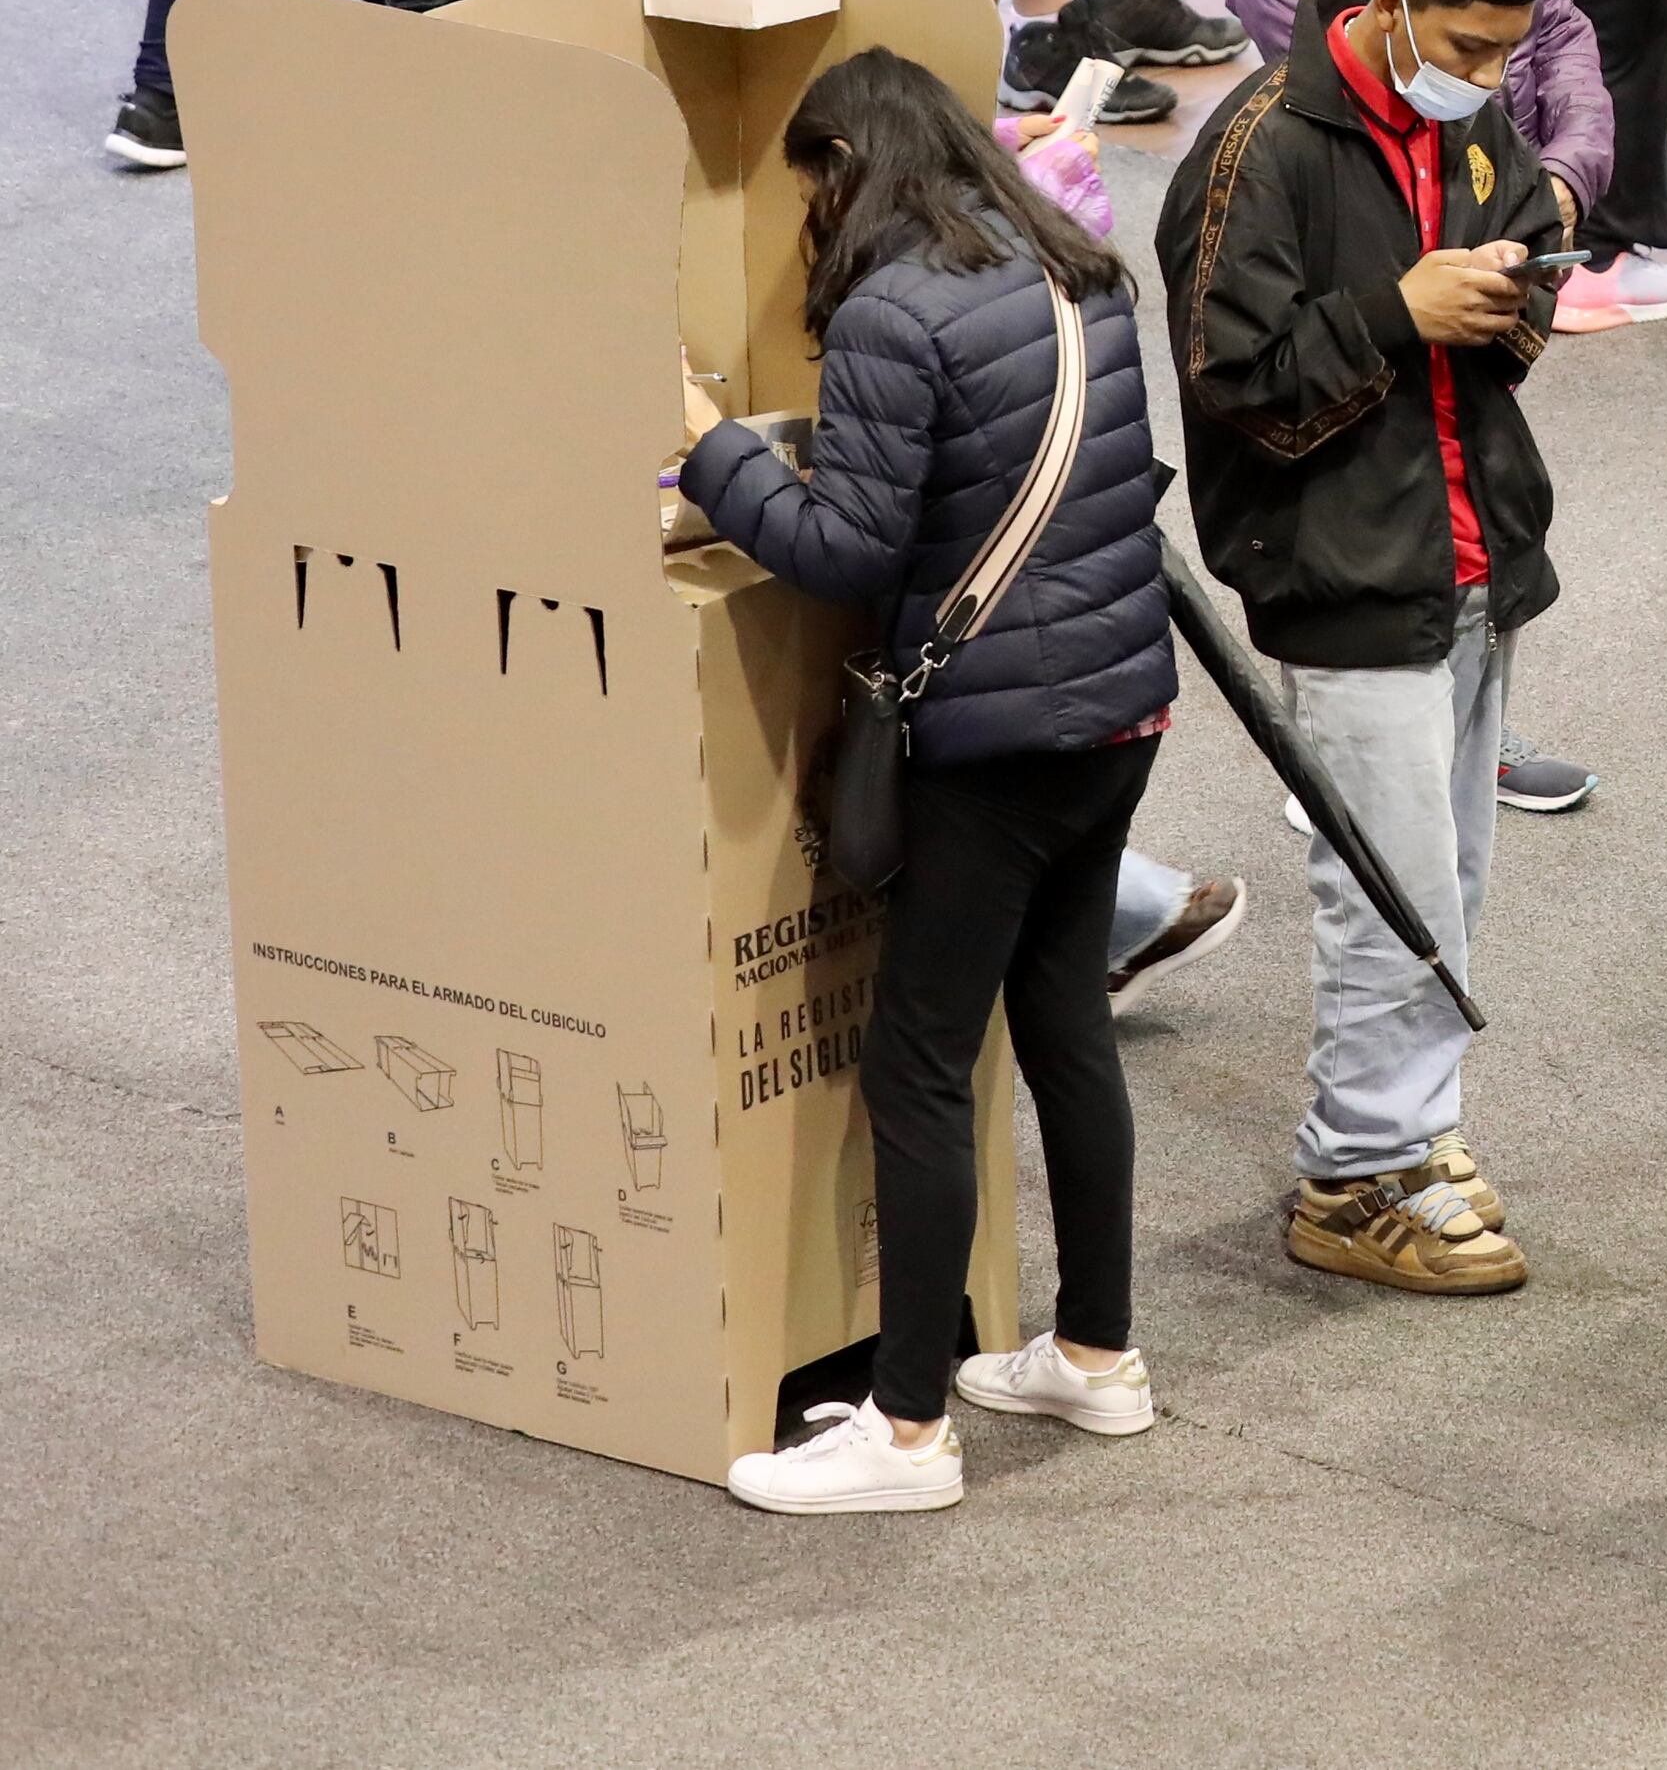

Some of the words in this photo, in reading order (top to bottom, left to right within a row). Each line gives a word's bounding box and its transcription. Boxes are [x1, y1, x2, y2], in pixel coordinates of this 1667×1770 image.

[1219, 117, 1251, 177] VERSACE
[735, 940, 820, 992] NACIONAL
[252, 942, 368, 982] INSTRUCCIONES
[370, 969, 409, 993] PARA
[412, 980, 430, 998] EL
[433, 985, 496, 1013] ARMADO
[499, 1000, 528, 1021] DEL
[531, 1009, 607, 1039] CUBICULO
[739, 1021, 764, 1058] LA
[740, 1057, 785, 1112] DEL
[789, 1024, 863, 1090] SIGLO
[275, 1105, 285, 1118] A
[387, 1131, 396, 1145] B
[490, 1158, 500, 1171] C
[618, 1188, 627, 1202] D
[347, 1304, 358, 1319] E
[453, 1332, 462, 1347] F
[556, 1360, 568, 1376] G
